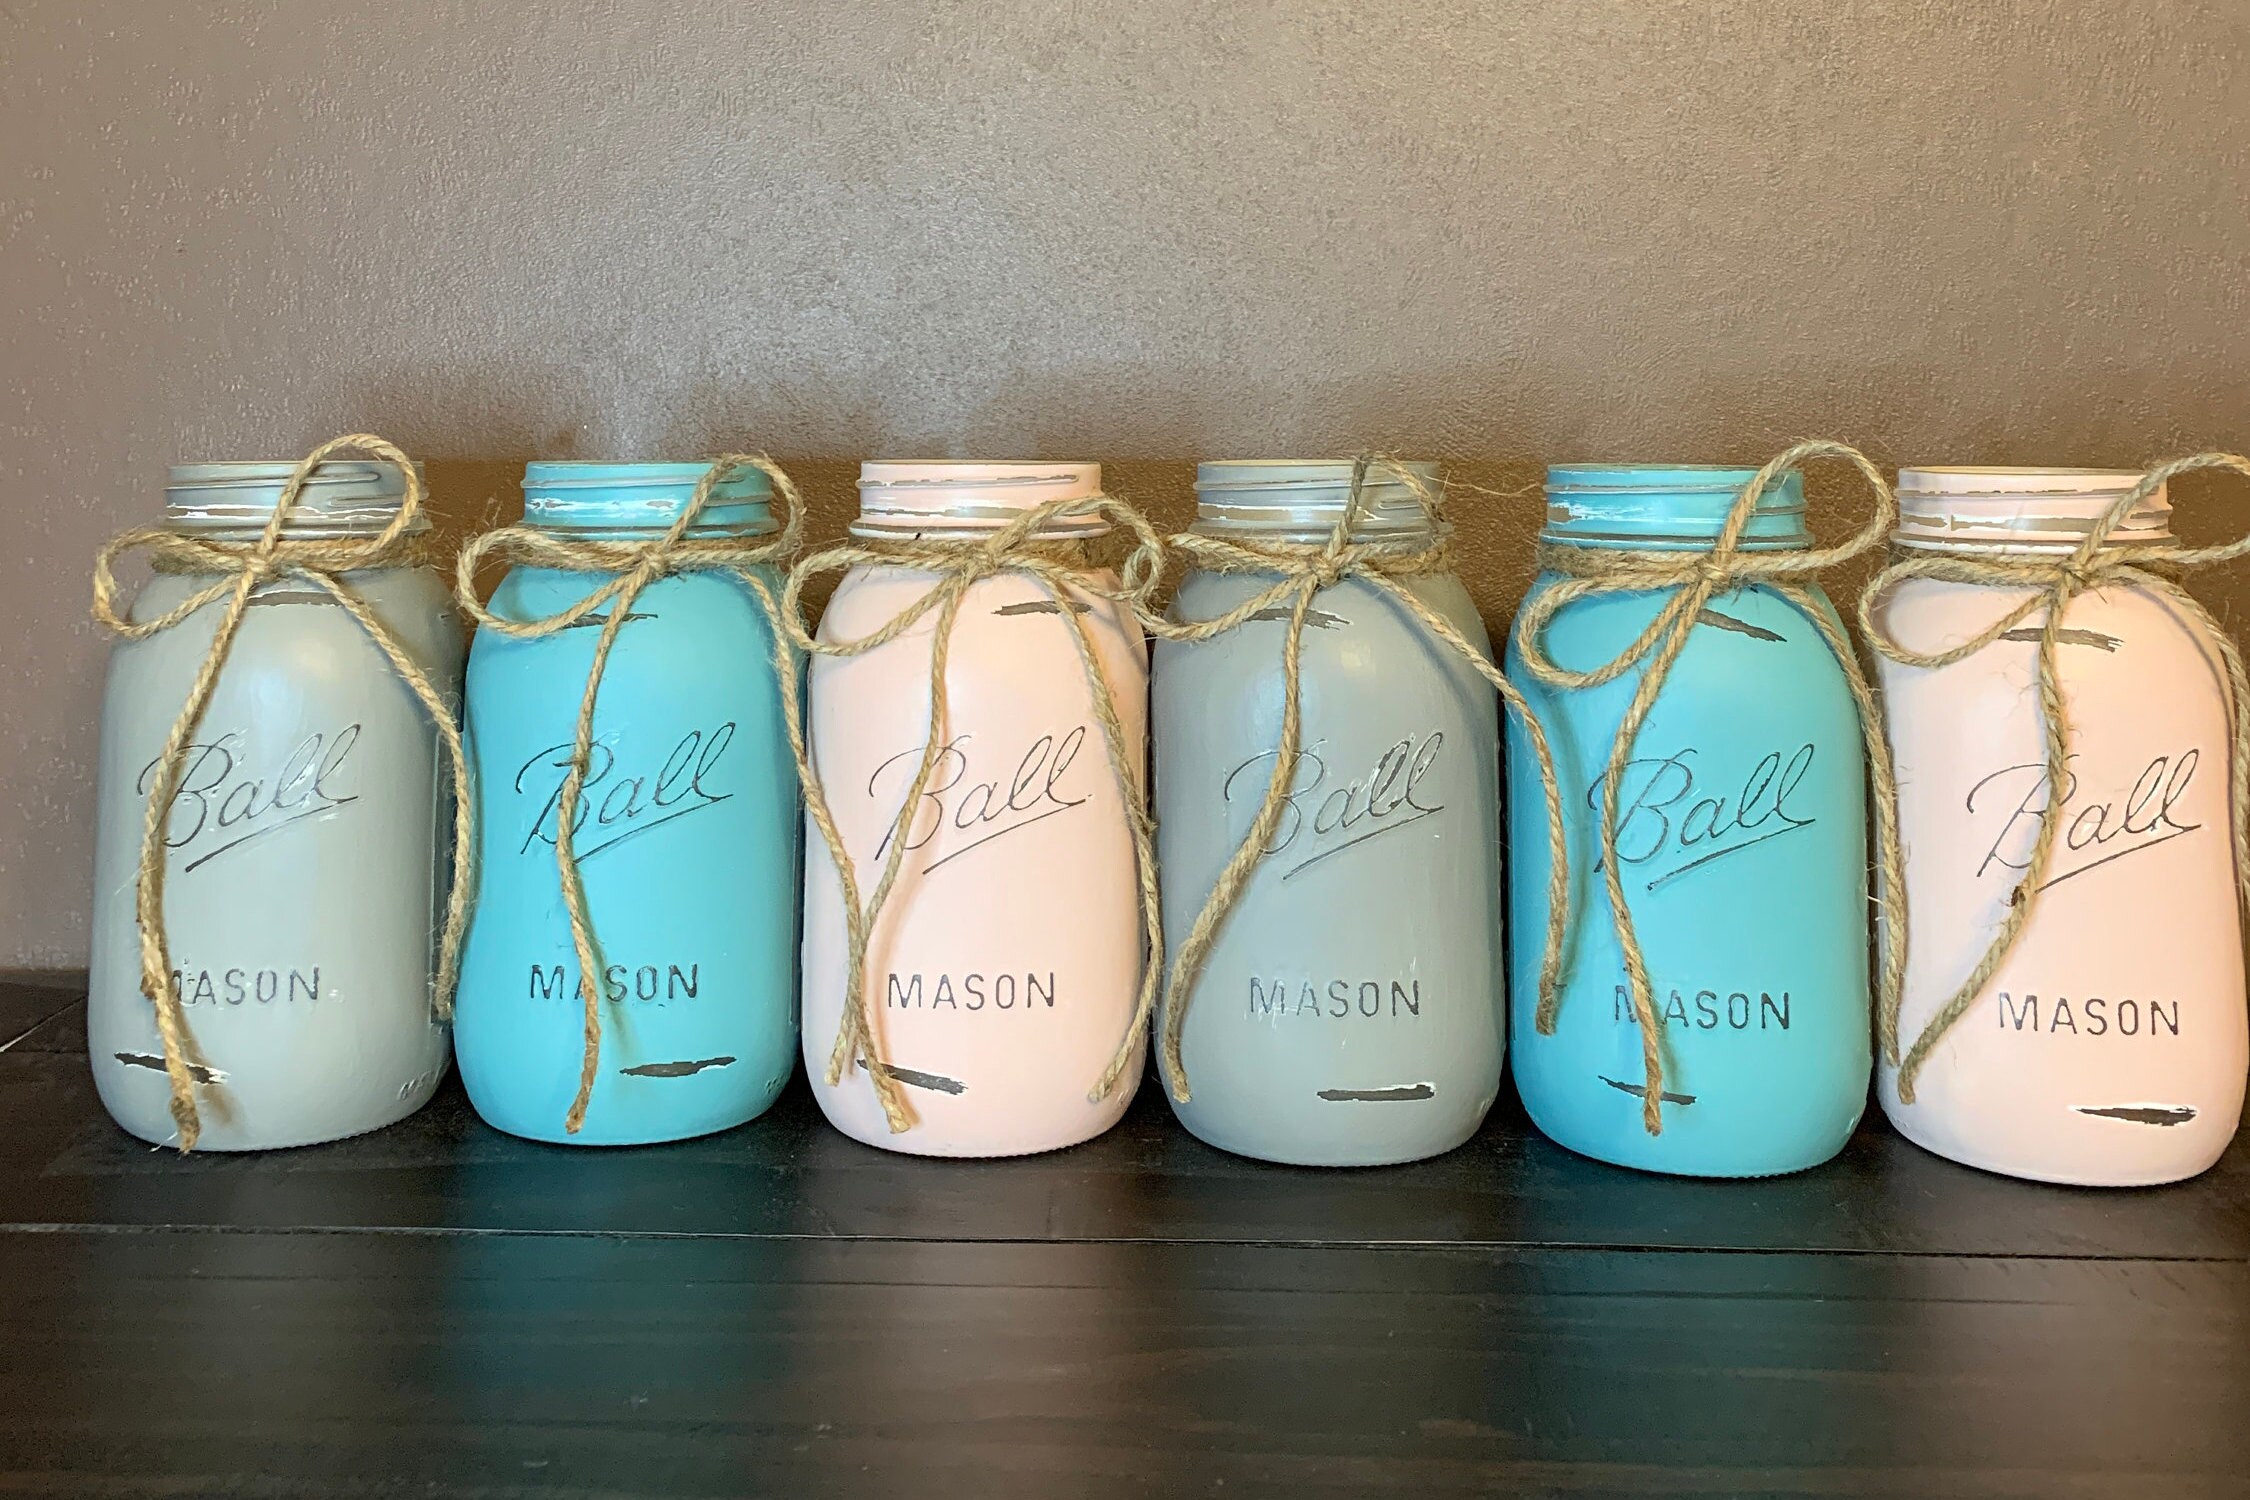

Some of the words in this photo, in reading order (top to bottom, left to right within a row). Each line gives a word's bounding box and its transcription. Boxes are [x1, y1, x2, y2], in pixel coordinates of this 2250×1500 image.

[137, 723, 360, 873] Ball
[515, 721, 737, 865] Ball
[868, 725, 1087, 875] Ball
[1224, 731, 1445, 880] Ball
[1586, 743, 1816, 891] Ball
[1966, 748, 2202, 894] Ball
[172, 966, 320, 1005] ASON
[530, 963, 699, 1003] MSON
[887, 971, 1056, 1010] MASON
[1249, 976, 1420, 1018] MASON
[1998, 991, 2180, 1036] MASON
